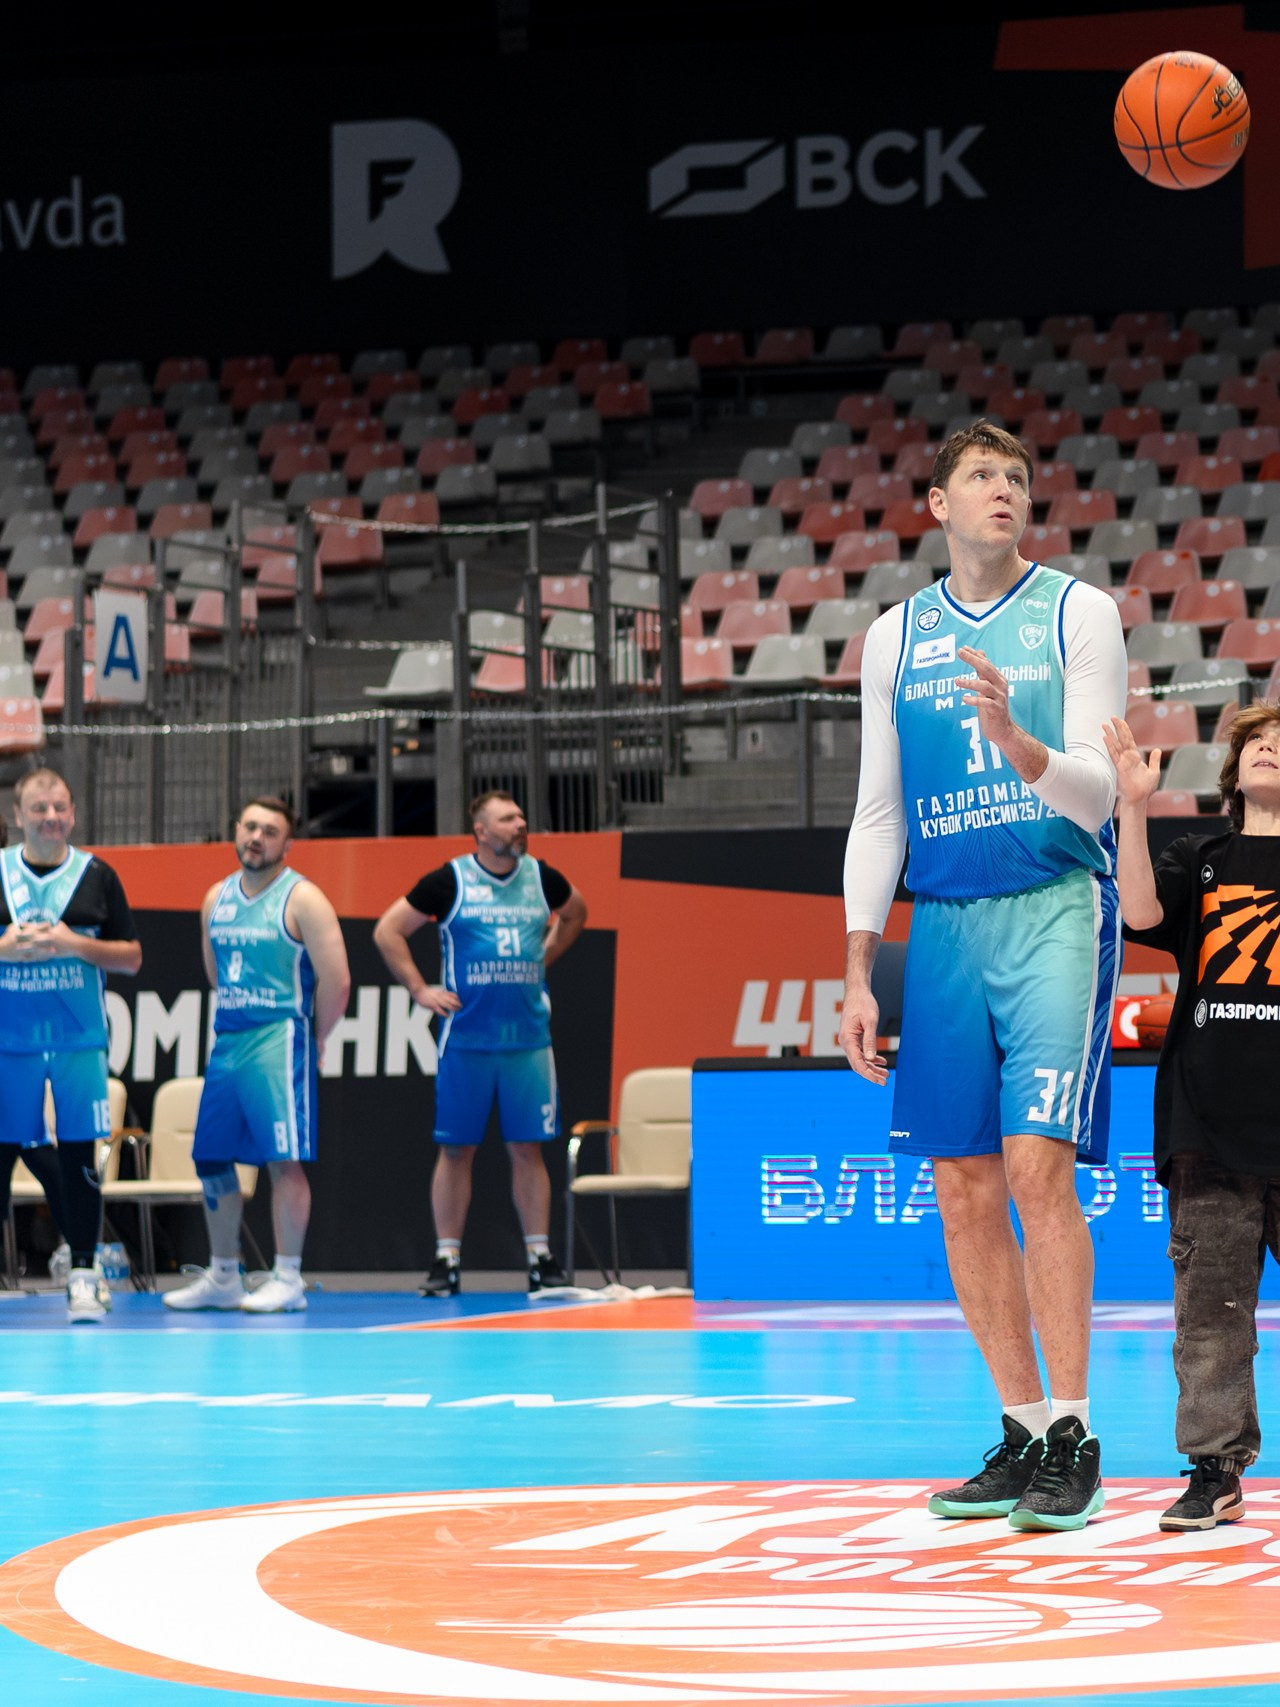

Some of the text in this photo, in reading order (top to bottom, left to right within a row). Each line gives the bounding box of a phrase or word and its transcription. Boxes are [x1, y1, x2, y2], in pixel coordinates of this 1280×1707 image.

[797, 125, 987, 209] ВСК
[0, 174, 126, 249] vda
[960, 716, 1003, 775] 31
[916, 781, 1032, 818] ГАЗПРОМБА
[920, 813, 962, 839] КУБОК
[964, 803, 1020, 831] РОССИИ
[496, 926, 521, 957] 21
[1027, 1067, 1075, 1126] 31
